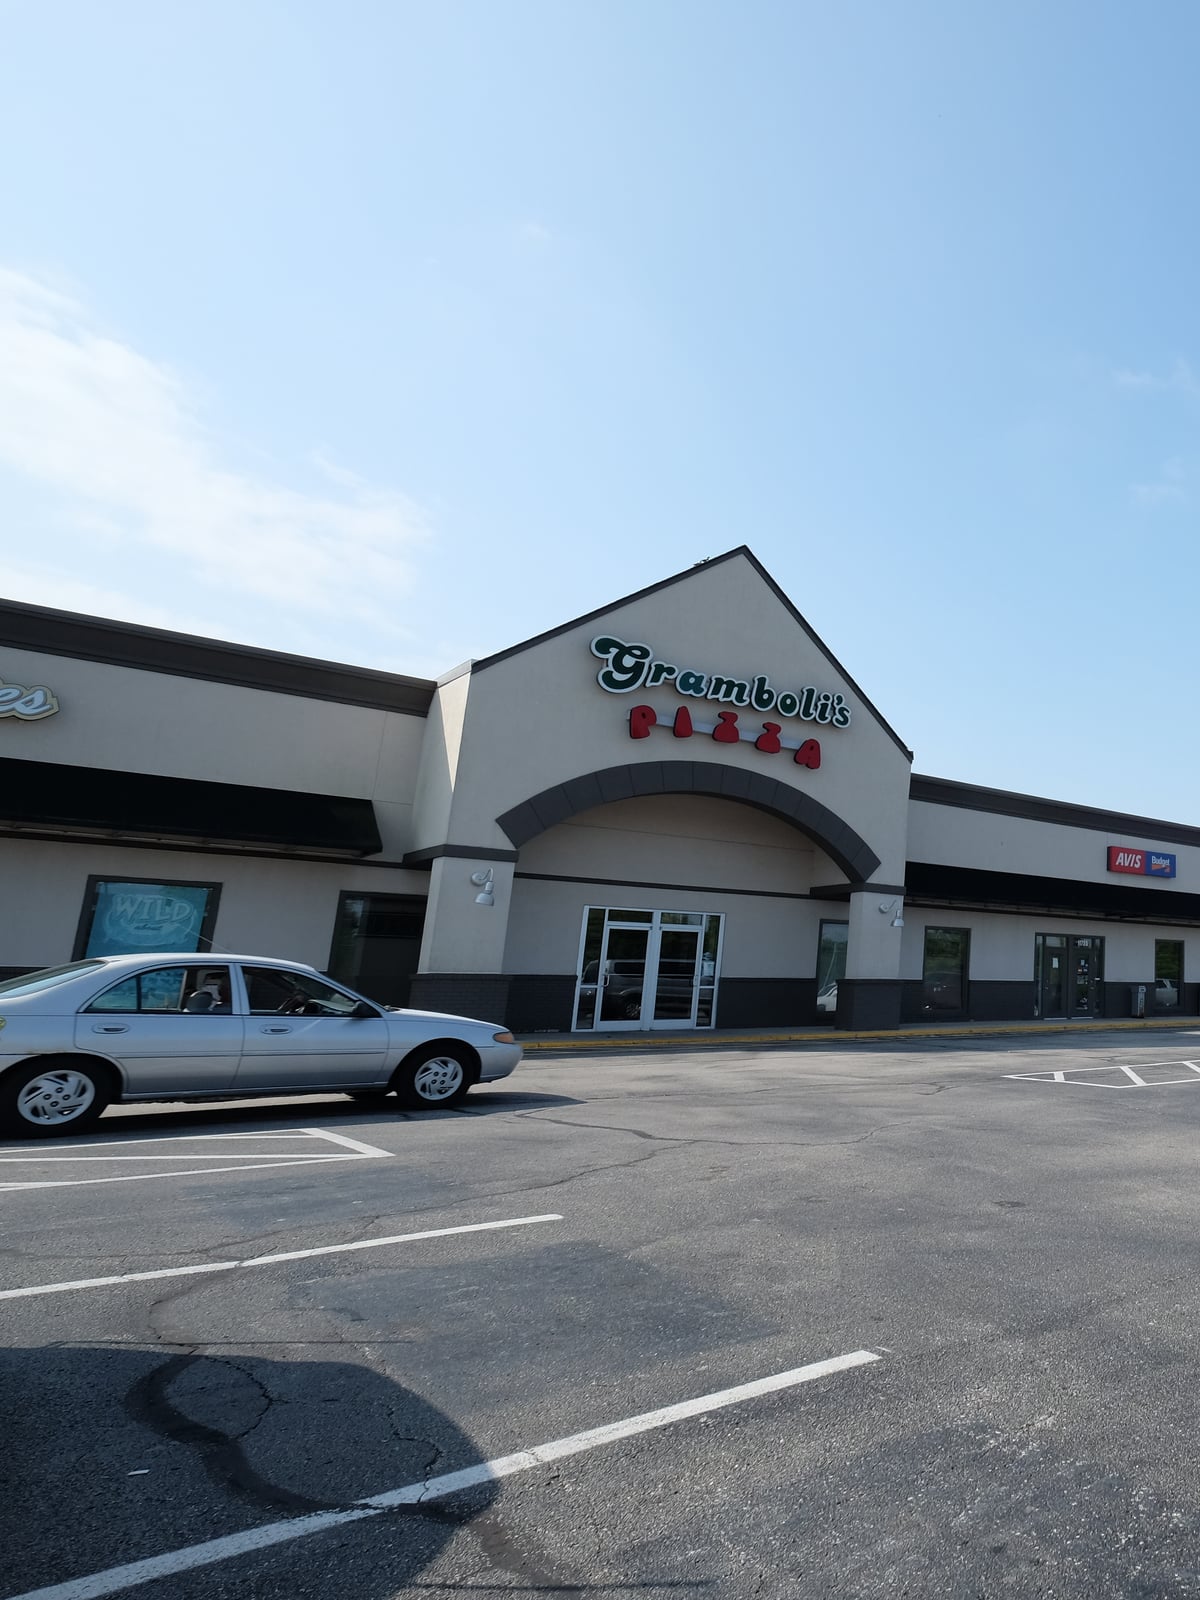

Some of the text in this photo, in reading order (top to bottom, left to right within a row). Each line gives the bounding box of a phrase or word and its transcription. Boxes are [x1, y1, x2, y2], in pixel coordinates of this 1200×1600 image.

[590, 635, 851, 728] Gramboli's
[628, 704, 822, 770] PIZZA
[1115, 852, 1142, 868] AVIS
[1151, 855, 1171, 867] Budget
[111, 893, 195, 923] WILD
